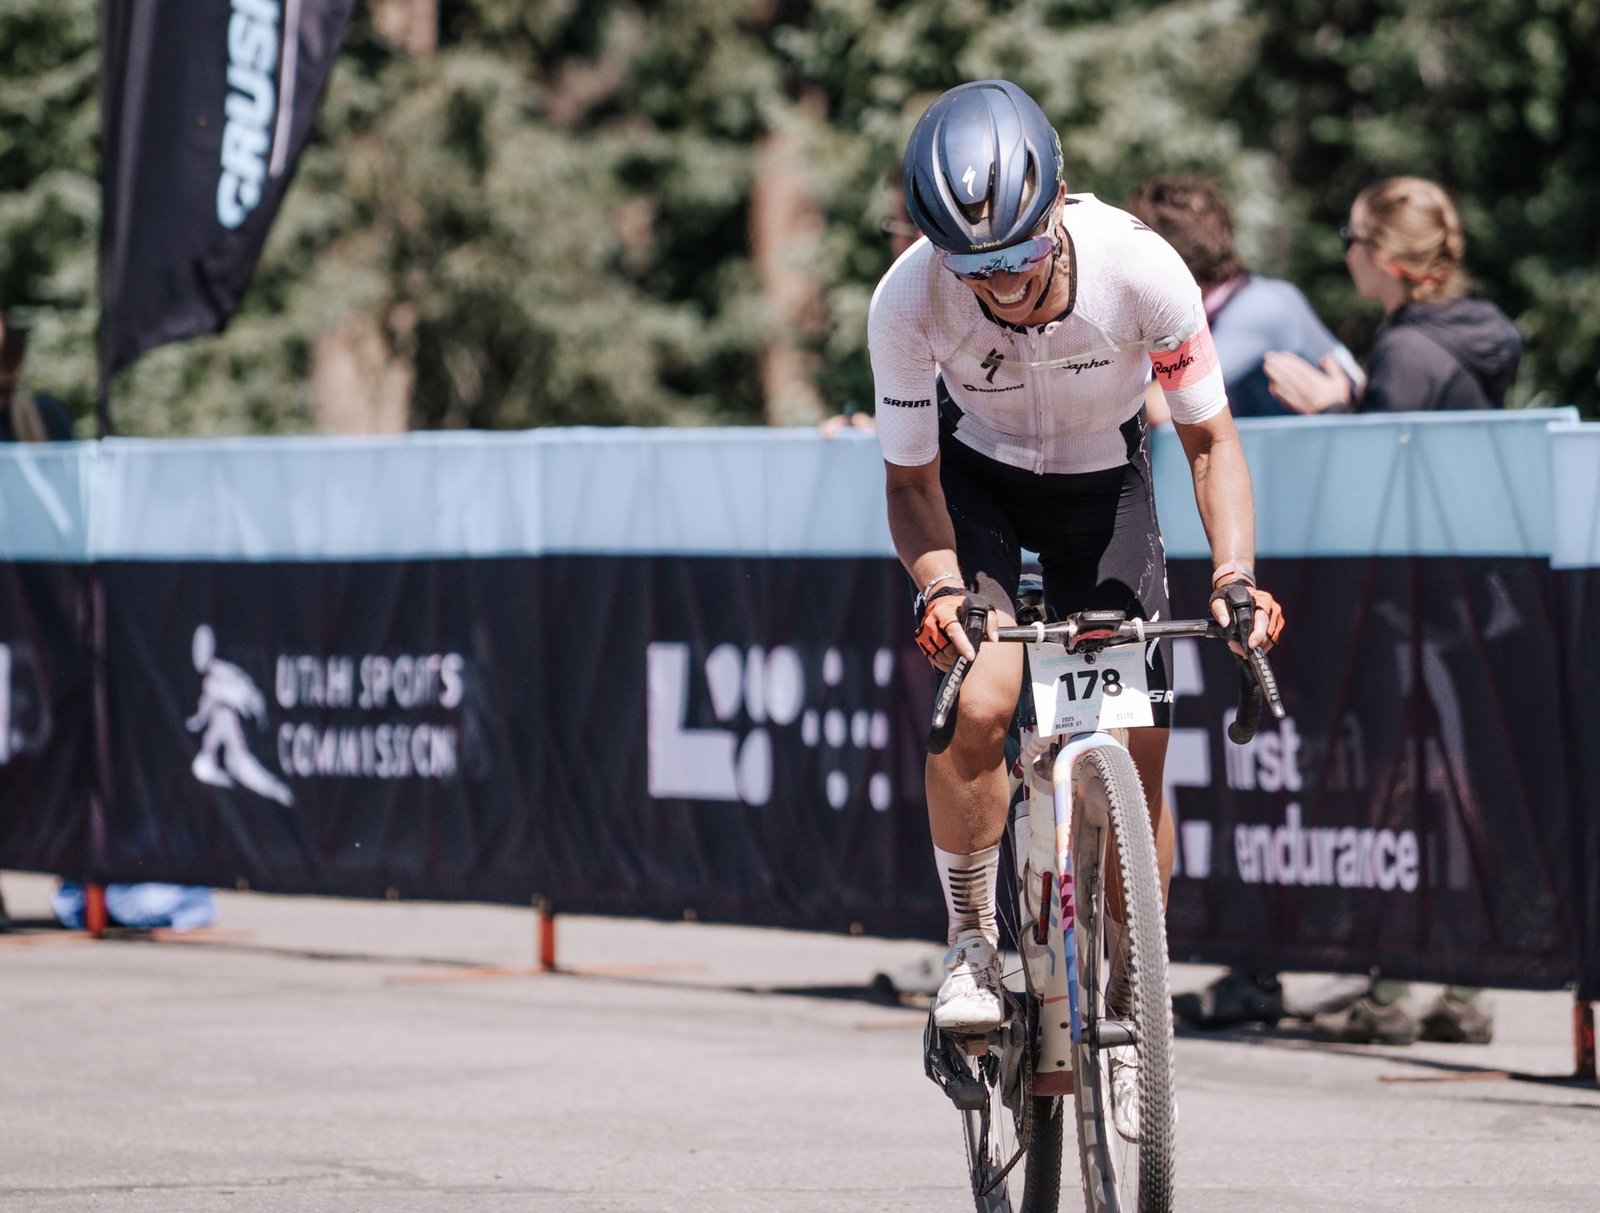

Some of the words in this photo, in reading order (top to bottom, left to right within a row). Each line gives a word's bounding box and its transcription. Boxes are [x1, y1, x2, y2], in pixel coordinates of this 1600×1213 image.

[970, 243, 983, 251] The
[1152, 354, 1194, 379] Rapha
[883, 396, 931, 408] SRAM
[276, 654, 354, 709] UTAH
[358, 653, 464, 709] SPORTS
[936, 655, 968, 713] SRAM
[1059, 668, 1123, 702] 178
[1148, 689, 1174, 703] SR
[1116, 711, 1134, 721] ELITE
[278, 723, 457, 778] COMMISSION
[1235, 802, 1419, 892] endurance
